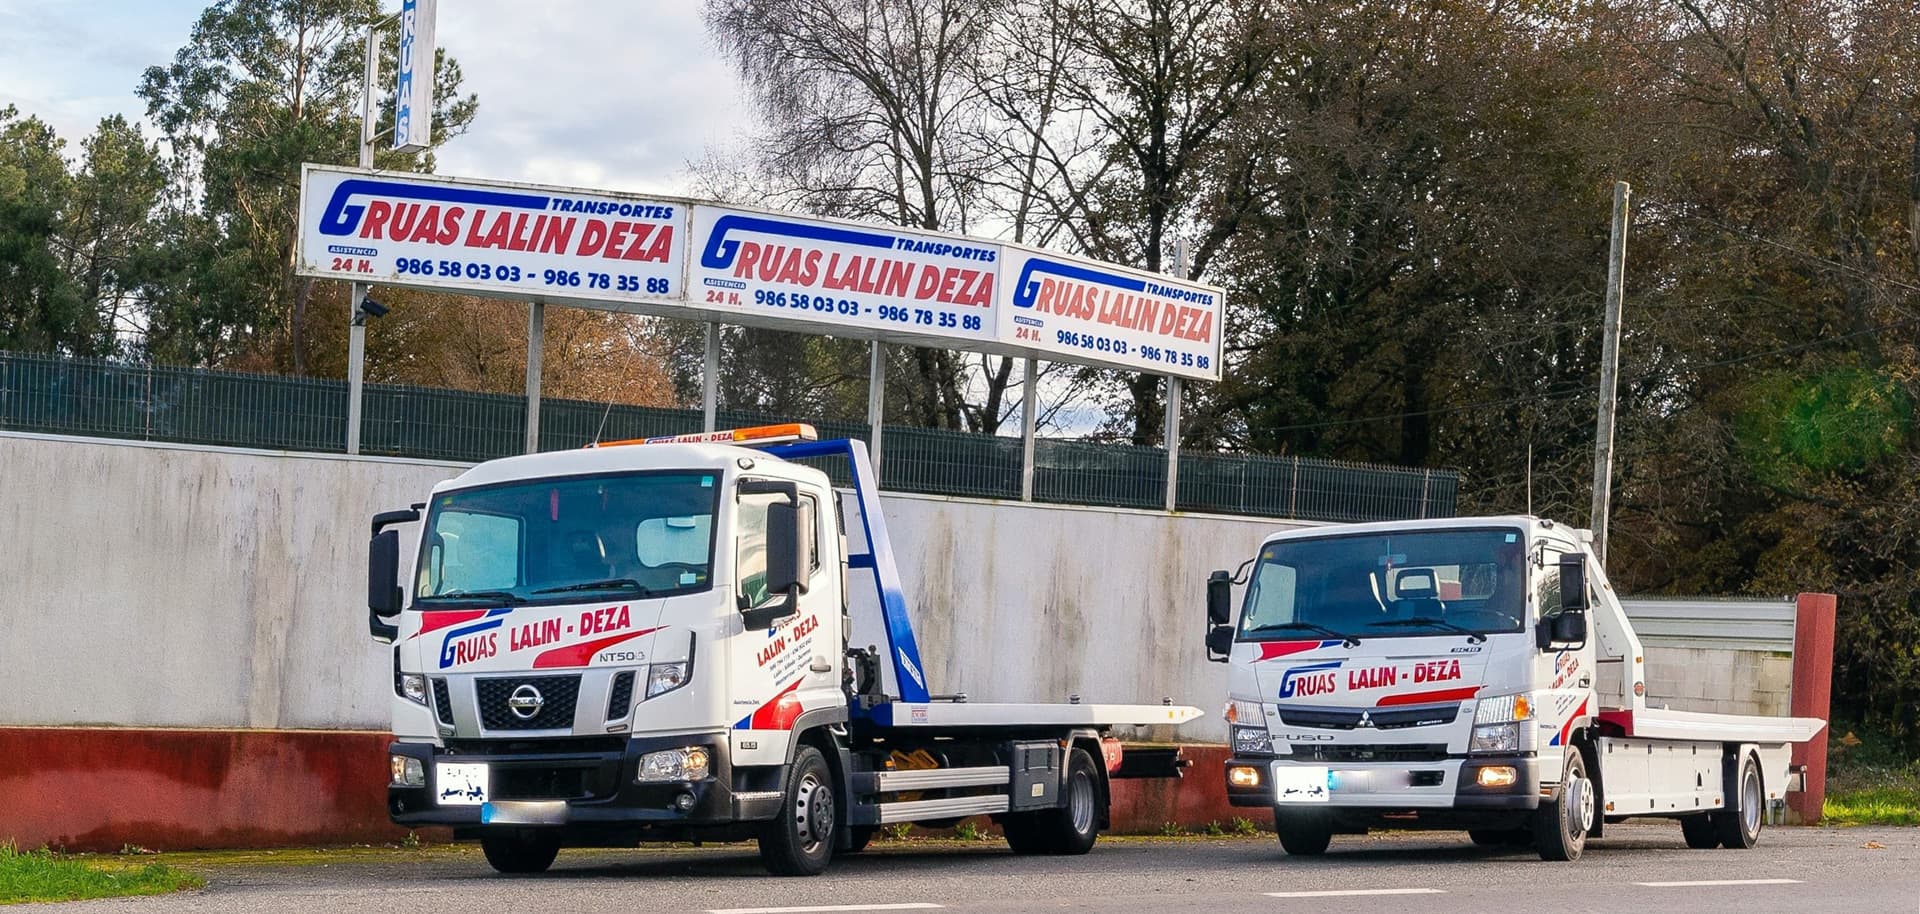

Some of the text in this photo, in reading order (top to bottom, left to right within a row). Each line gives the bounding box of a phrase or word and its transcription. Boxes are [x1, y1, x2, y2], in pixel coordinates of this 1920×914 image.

[551, 198, 674, 219] TRANSPORTES
[319, 179, 674, 263] GRUAS LALIN DEZA
[328, 246, 378, 256] ASISTENCIA
[701, 215, 995, 308] GRUAS LALIN DEZA
[897, 238, 996, 262] TRANSPORTES
[331, 258, 374, 273] 24 H.
[395, 257, 434, 276] 986
[438, 260, 462, 277] 58
[466, 263, 491, 280] 03
[495, 265, 521, 282] 03
[544, 269, 581, 287] 986
[588, 272, 610, 289] 78
[617, 275, 640, 292] 35
[646, 277, 669, 294] 88
[705, 279, 746, 289] ASISTENCIA
[1147, 282, 1213, 306] TRANSPORTES
[706, 290, 742, 306] 24 H.
[755, 289, 787, 307] 986
[790, 293, 810, 309] 58
[813, 296, 835, 313] 03
[838, 299, 859, 316] 03
[878, 304, 909, 322] 986
[914, 308, 933, 325] 78
[938, 312, 957, 328] 35
[962, 314, 981, 331] 88
[1013, 257, 1213, 343] GRUAS LALIN DEZA
[1015, 326, 1029, 340] 24
[1056, 329, 1079, 346] 986
[1081, 334, 1094, 350] 58
[1140, 345, 1161, 361] 986
[1165, 350, 1177, 365] 78
[1180, 353, 1193, 367] 35
[1196, 355, 1210, 370] 88
[711, 432, 732, 442] DEZA
[439, 622, 501, 669] GRUAS
[510, 618, 562, 652] LALIN
[580, 605, 631, 637] DEZA
[757, 635, 786, 668] LALIN
[793, 614, 819, 642] DEZA
[1278, 662, 1339, 699] GRUAS
[1348, 667, 1397, 691] LALIN
[1413, 659, 1461, 684] DEZA
[1271, 733, 1335, 742] FUSO
